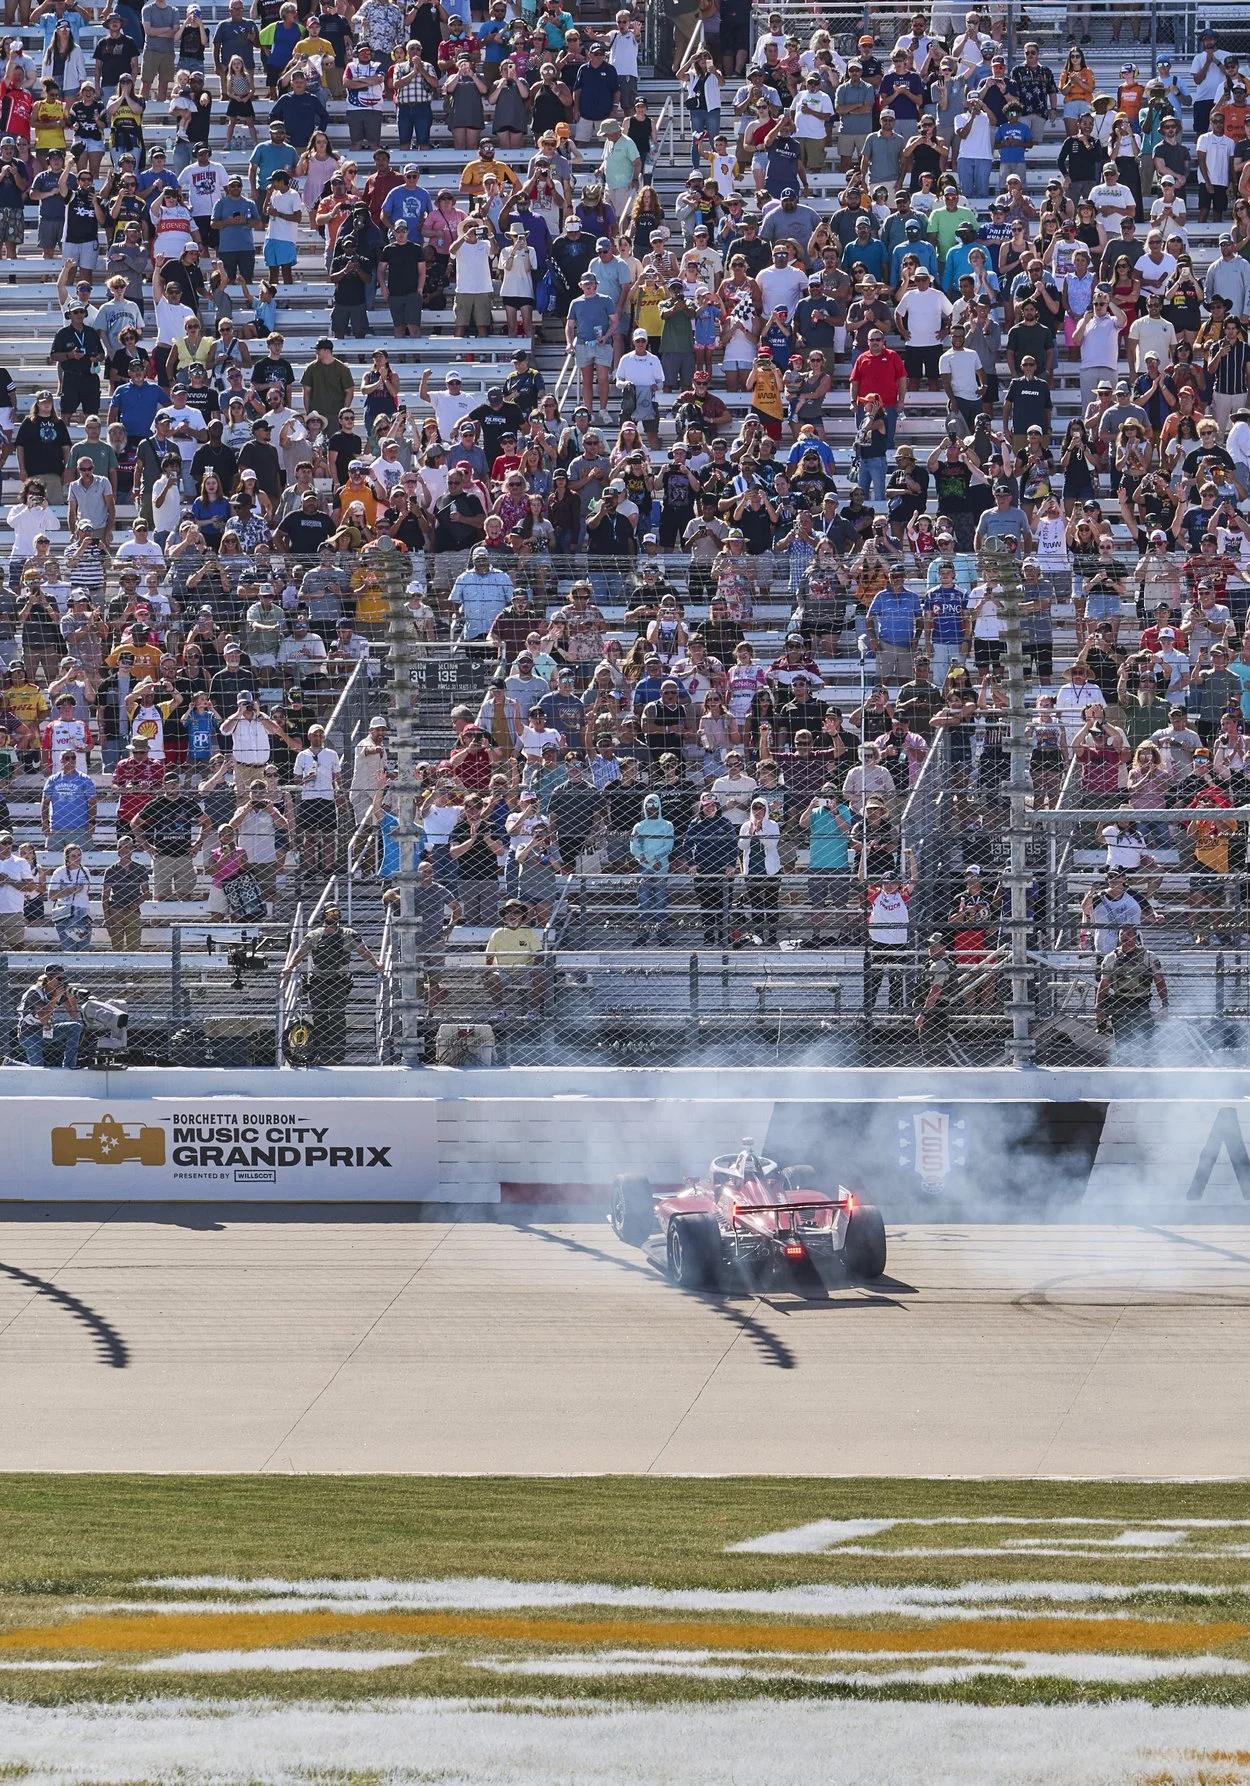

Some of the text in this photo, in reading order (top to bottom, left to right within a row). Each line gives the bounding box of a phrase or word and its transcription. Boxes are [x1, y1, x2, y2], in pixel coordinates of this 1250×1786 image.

[942, 603, 962, 613] PNC
[438, 670, 457, 682] 135
[990, 843, 1010, 855] 135
[1026, 843, 1041, 855] 35
[173, 1113, 296, 1125] BORCHETTA BOURBON
[173, 1127, 330, 1144] MUSIC CITY
